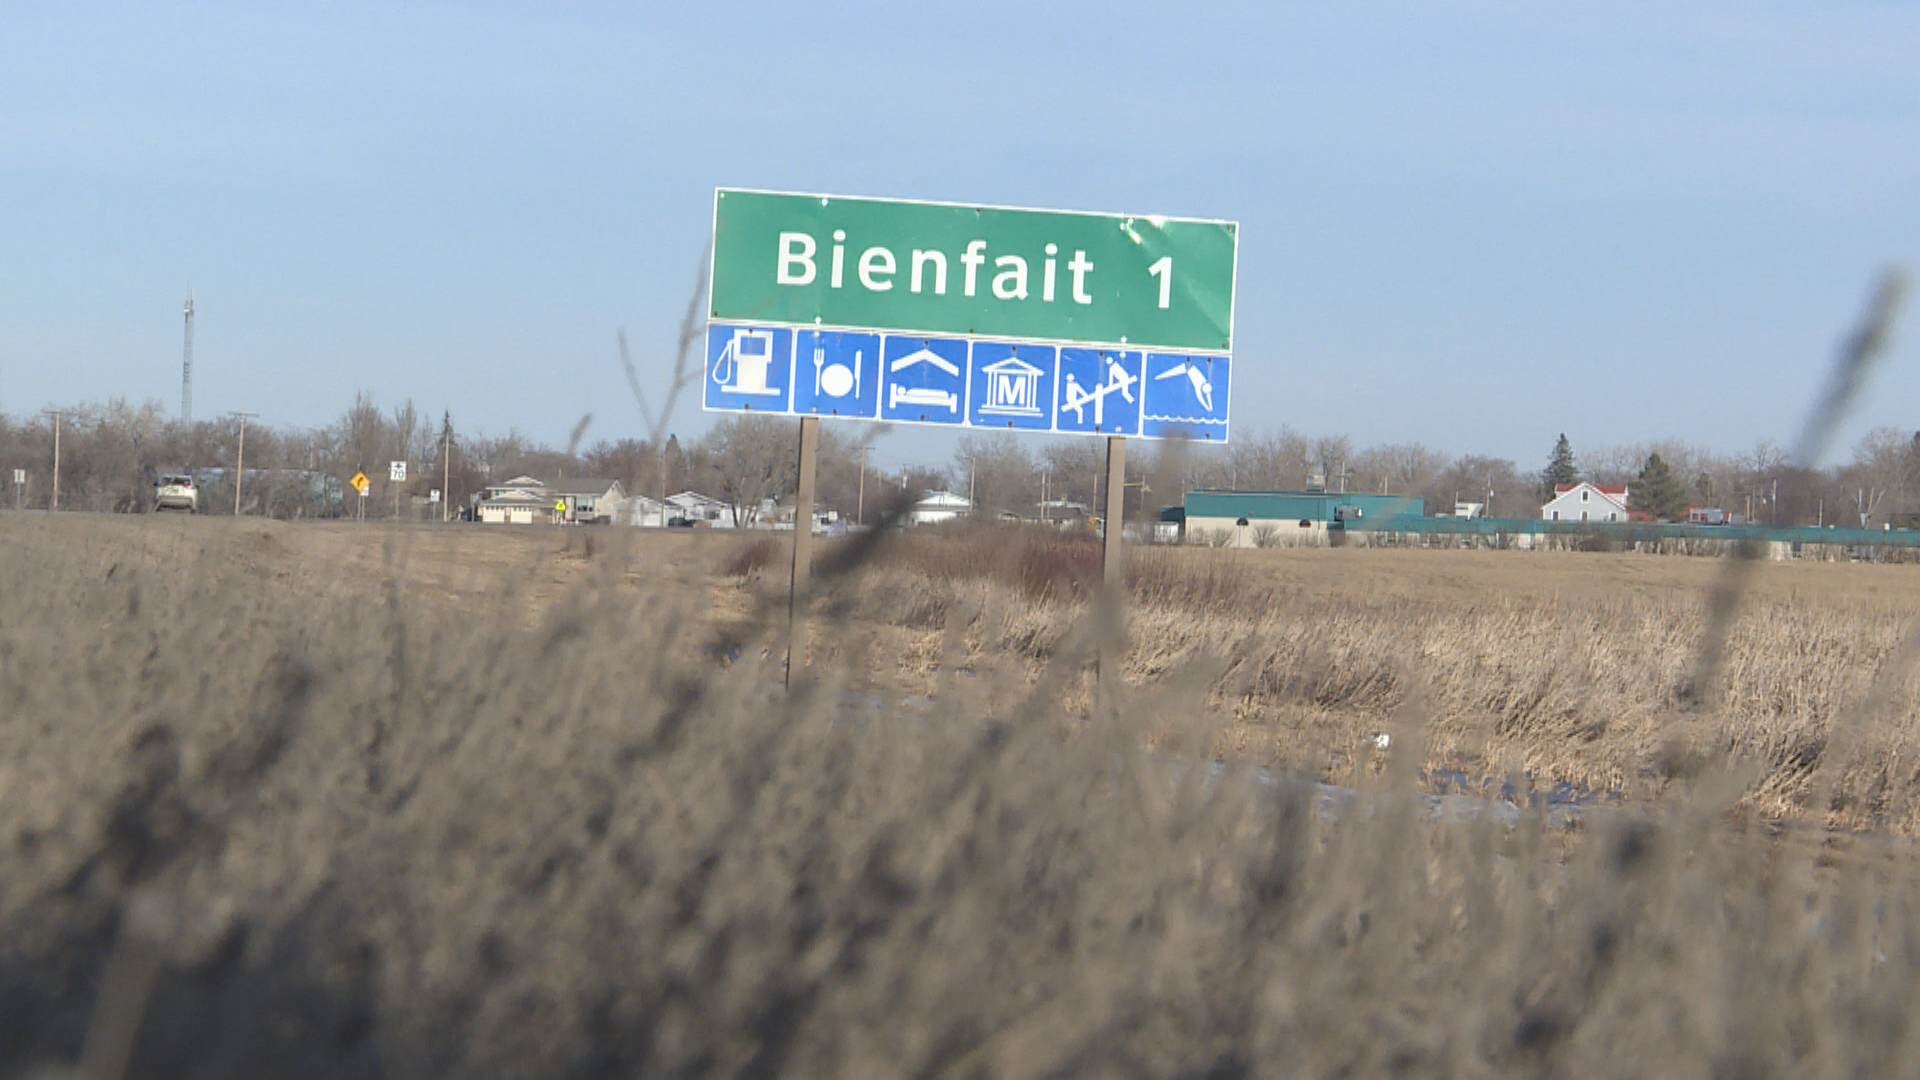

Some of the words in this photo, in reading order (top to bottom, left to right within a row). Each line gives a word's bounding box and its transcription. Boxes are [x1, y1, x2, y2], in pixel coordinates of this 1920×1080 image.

[776, 229, 1094, 305] Bienfait
[1148, 256, 1173, 309] 1
[998, 374, 1026, 405] M
[392, 470, 404, 479] 70
